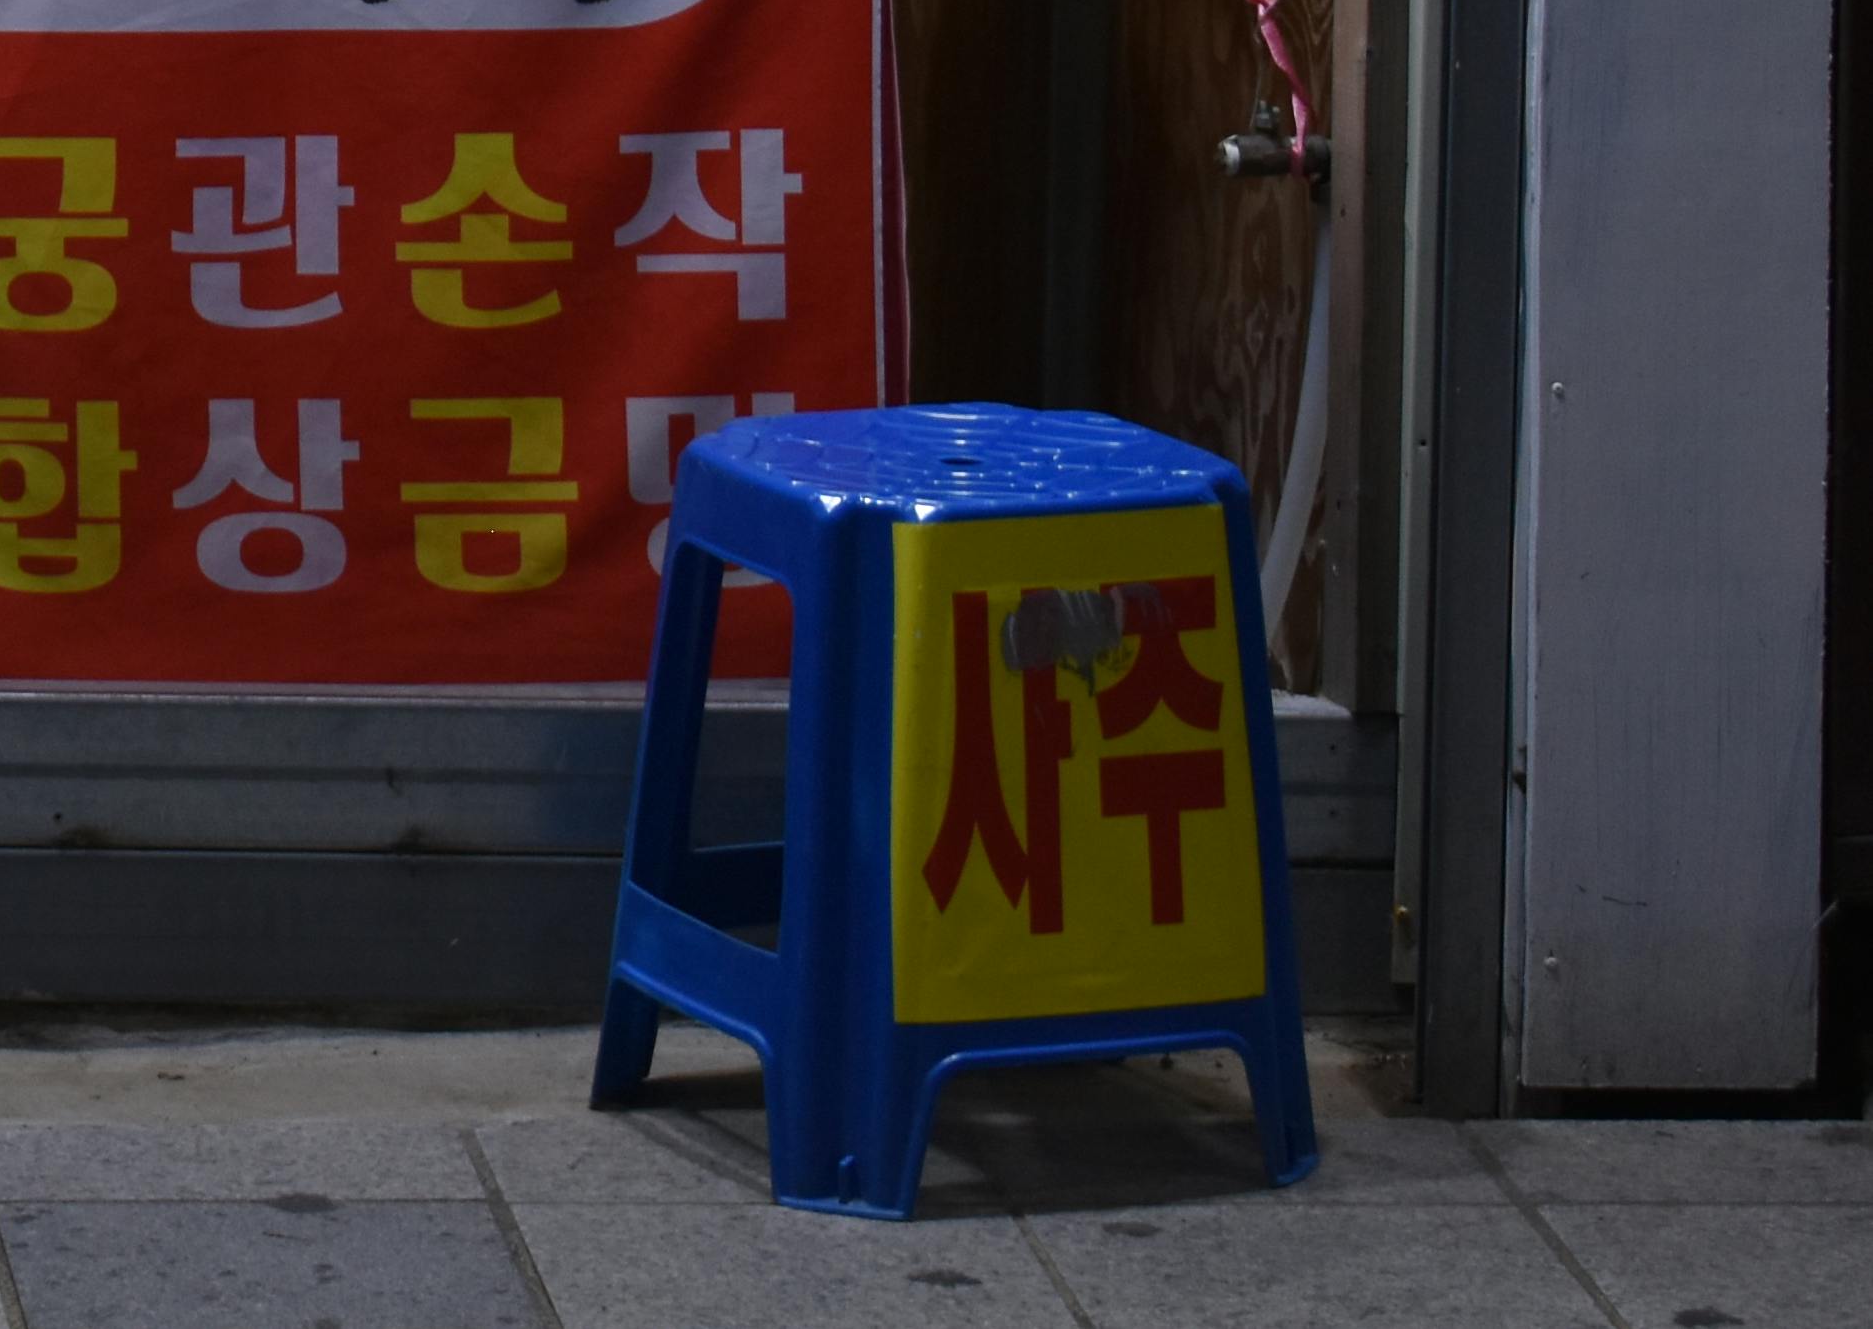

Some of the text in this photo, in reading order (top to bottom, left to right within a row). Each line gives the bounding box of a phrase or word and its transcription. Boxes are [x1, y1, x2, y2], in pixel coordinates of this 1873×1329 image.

[169, 133, 360, 595] 관상
[394, 132, 580, 596] 손금
[920, 575, 1226, 936] 사주
